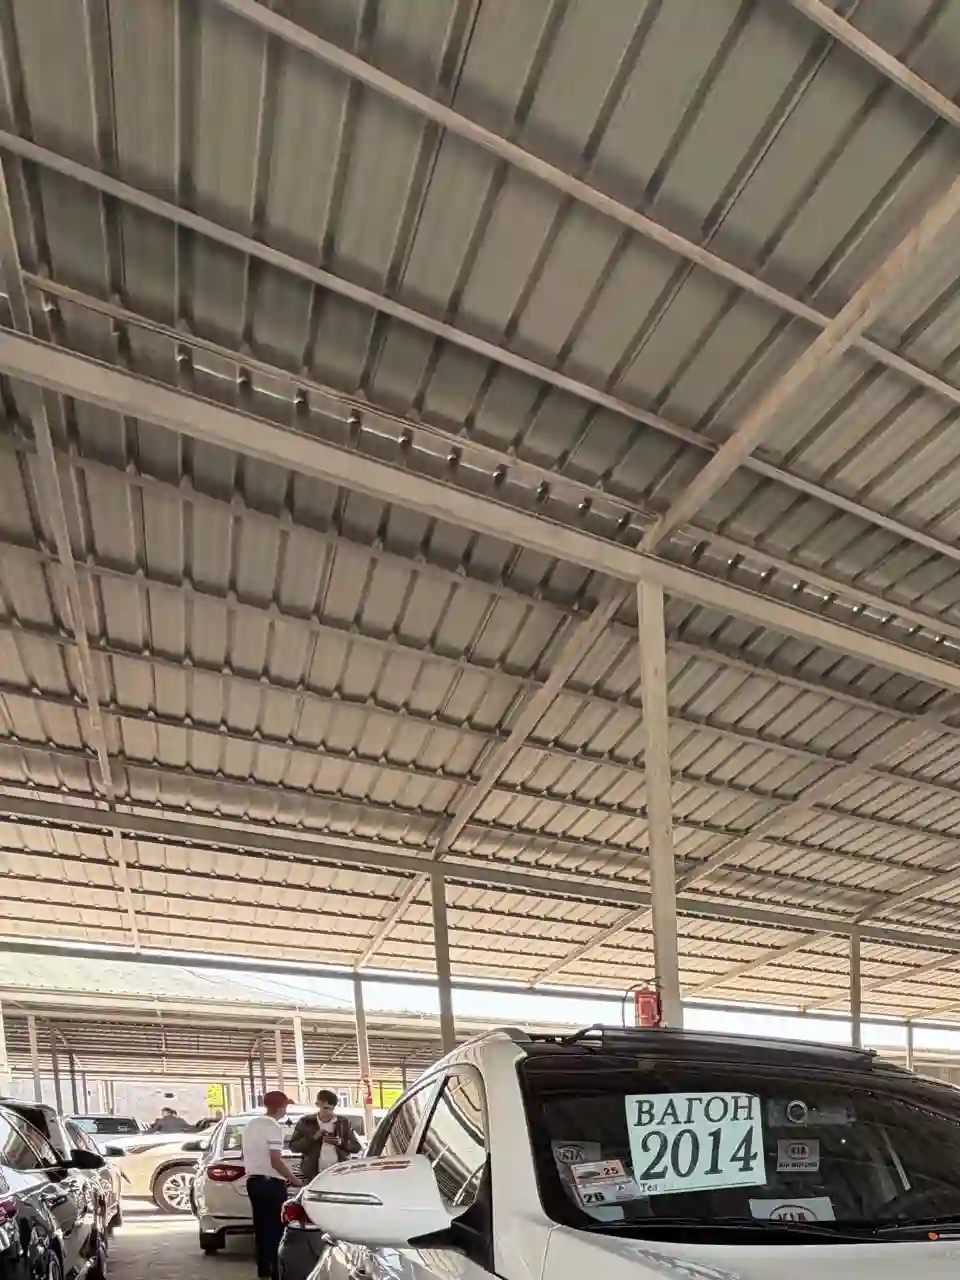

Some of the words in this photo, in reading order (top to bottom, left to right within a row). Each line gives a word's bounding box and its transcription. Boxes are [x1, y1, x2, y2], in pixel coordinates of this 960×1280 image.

[633, 1096, 755, 1127] ВАГОН
[639, 1124, 759, 1180] 2014
[603, 1166, 619, 1175] 25
